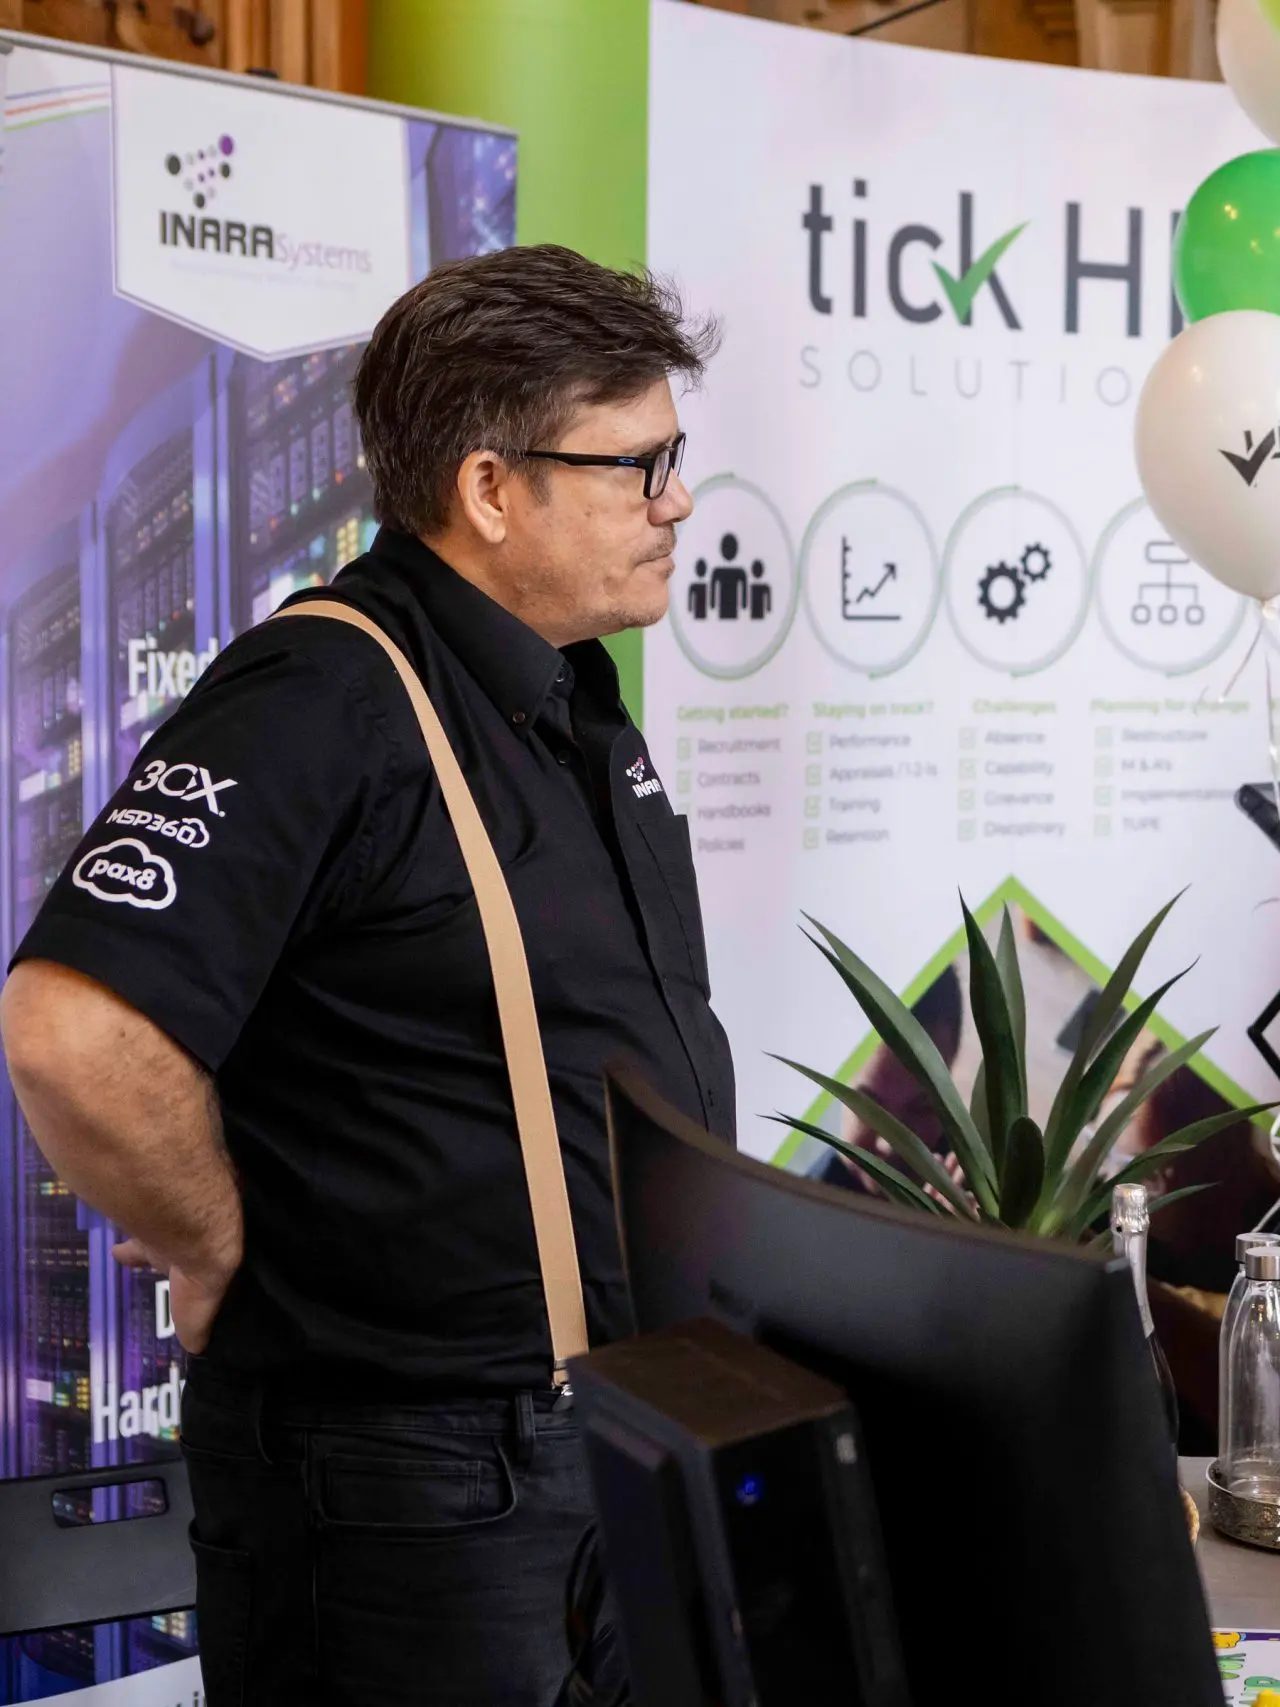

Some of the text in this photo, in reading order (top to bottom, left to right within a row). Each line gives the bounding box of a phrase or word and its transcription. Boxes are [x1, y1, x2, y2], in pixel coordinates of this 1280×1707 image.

[802, 179, 1024, 331] tick
[799, 345, 1132, 407] SOLUTIO
[106, 808, 199, 846] MSP360
[87, 858, 157, 890] pax8
[93, 1366, 186, 1444] Hard
